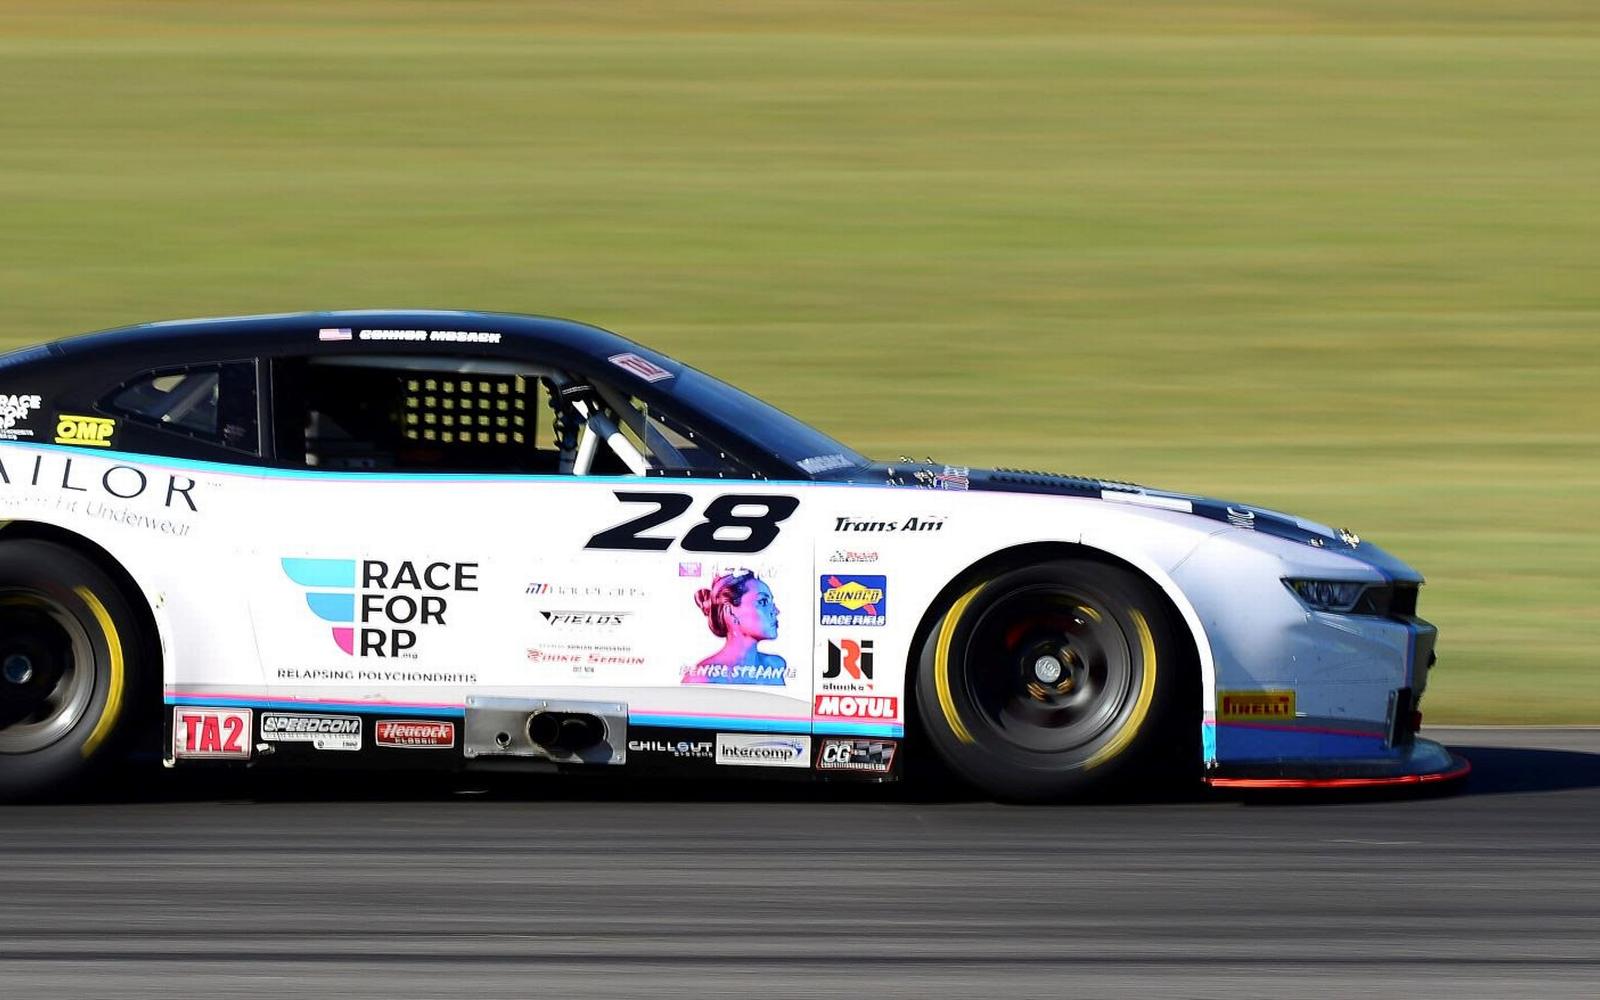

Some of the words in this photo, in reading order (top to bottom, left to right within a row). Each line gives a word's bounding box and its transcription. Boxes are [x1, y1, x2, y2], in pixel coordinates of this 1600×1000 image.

[56, 418, 114, 442] OMP
[584, 491, 800, 553] 28
[834, 516, 897, 532] Trans
[901, 516, 946, 532] Am
[362, 559, 479, 592] RACE
[826, 588, 880, 603] SUNOCO
[361, 594, 448, 625] FOR
[821, 615, 853, 626] RACE
[360, 628, 417, 658] RP
[277, 669, 354, 680] RELAPSING
[358, 672, 477, 683] POLYCHONDRITIS
[818, 696, 895, 717] MOTUL
[1223, 696, 1290, 716] PIRELLI
[182, 715, 245, 753] TA2
[264, 717, 359, 733] SPEEDCOM
[628, 740, 713, 753] CHILLOUT
[721, 744, 793, 762] Intercomp
[823, 744, 851, 763] CG
